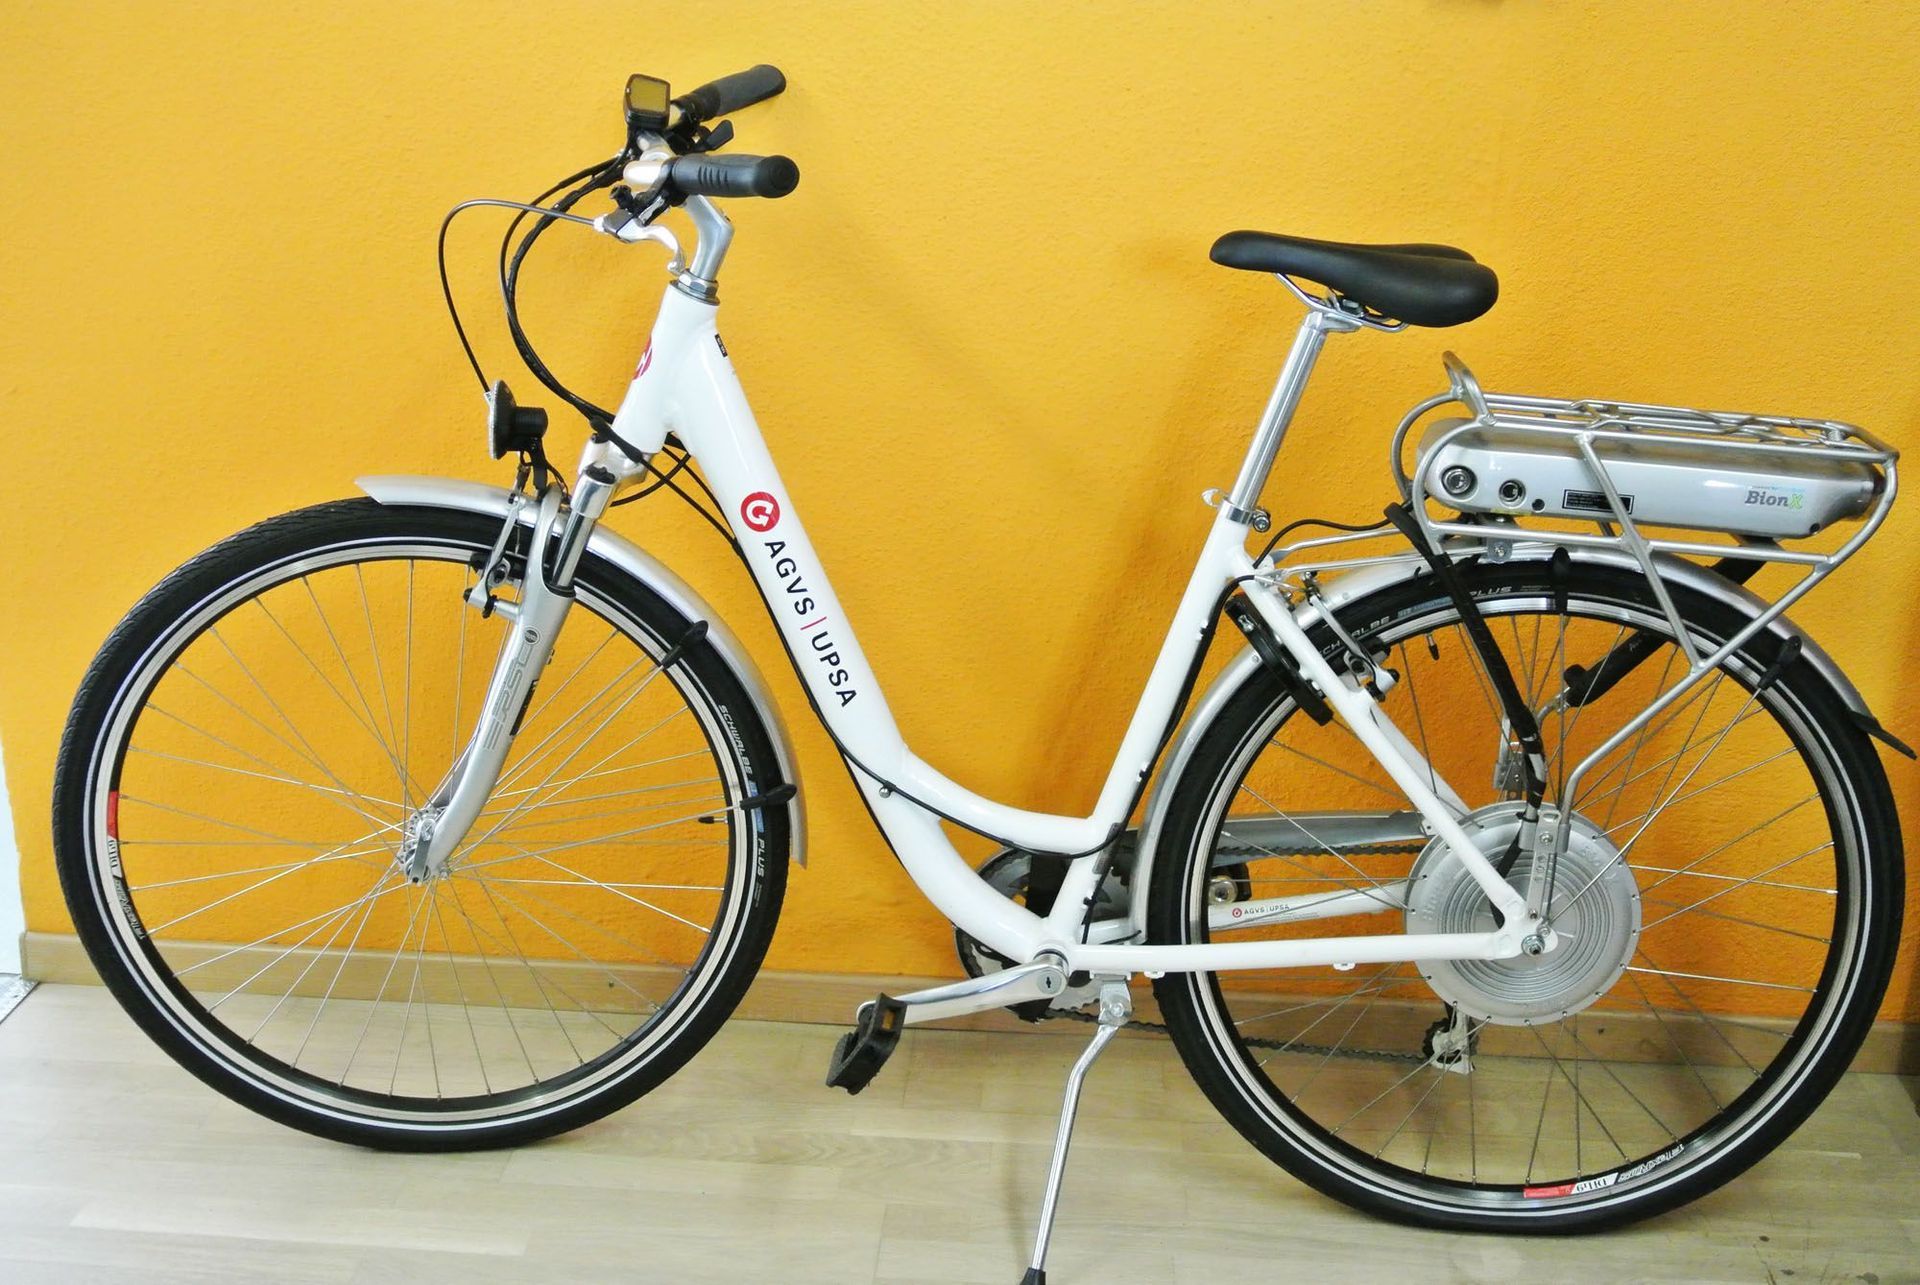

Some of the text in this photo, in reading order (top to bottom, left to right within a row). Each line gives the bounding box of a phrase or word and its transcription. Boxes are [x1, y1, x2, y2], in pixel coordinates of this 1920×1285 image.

[1744, 489, 1802, 510] BionX
[764, 540, 857, 708] AGVS UPSA
[1319, 615, 1390, 655] CHALBE
[718, 704, 753, 775] SCHWALBE
[757, 838, 765, 878] PLUS
